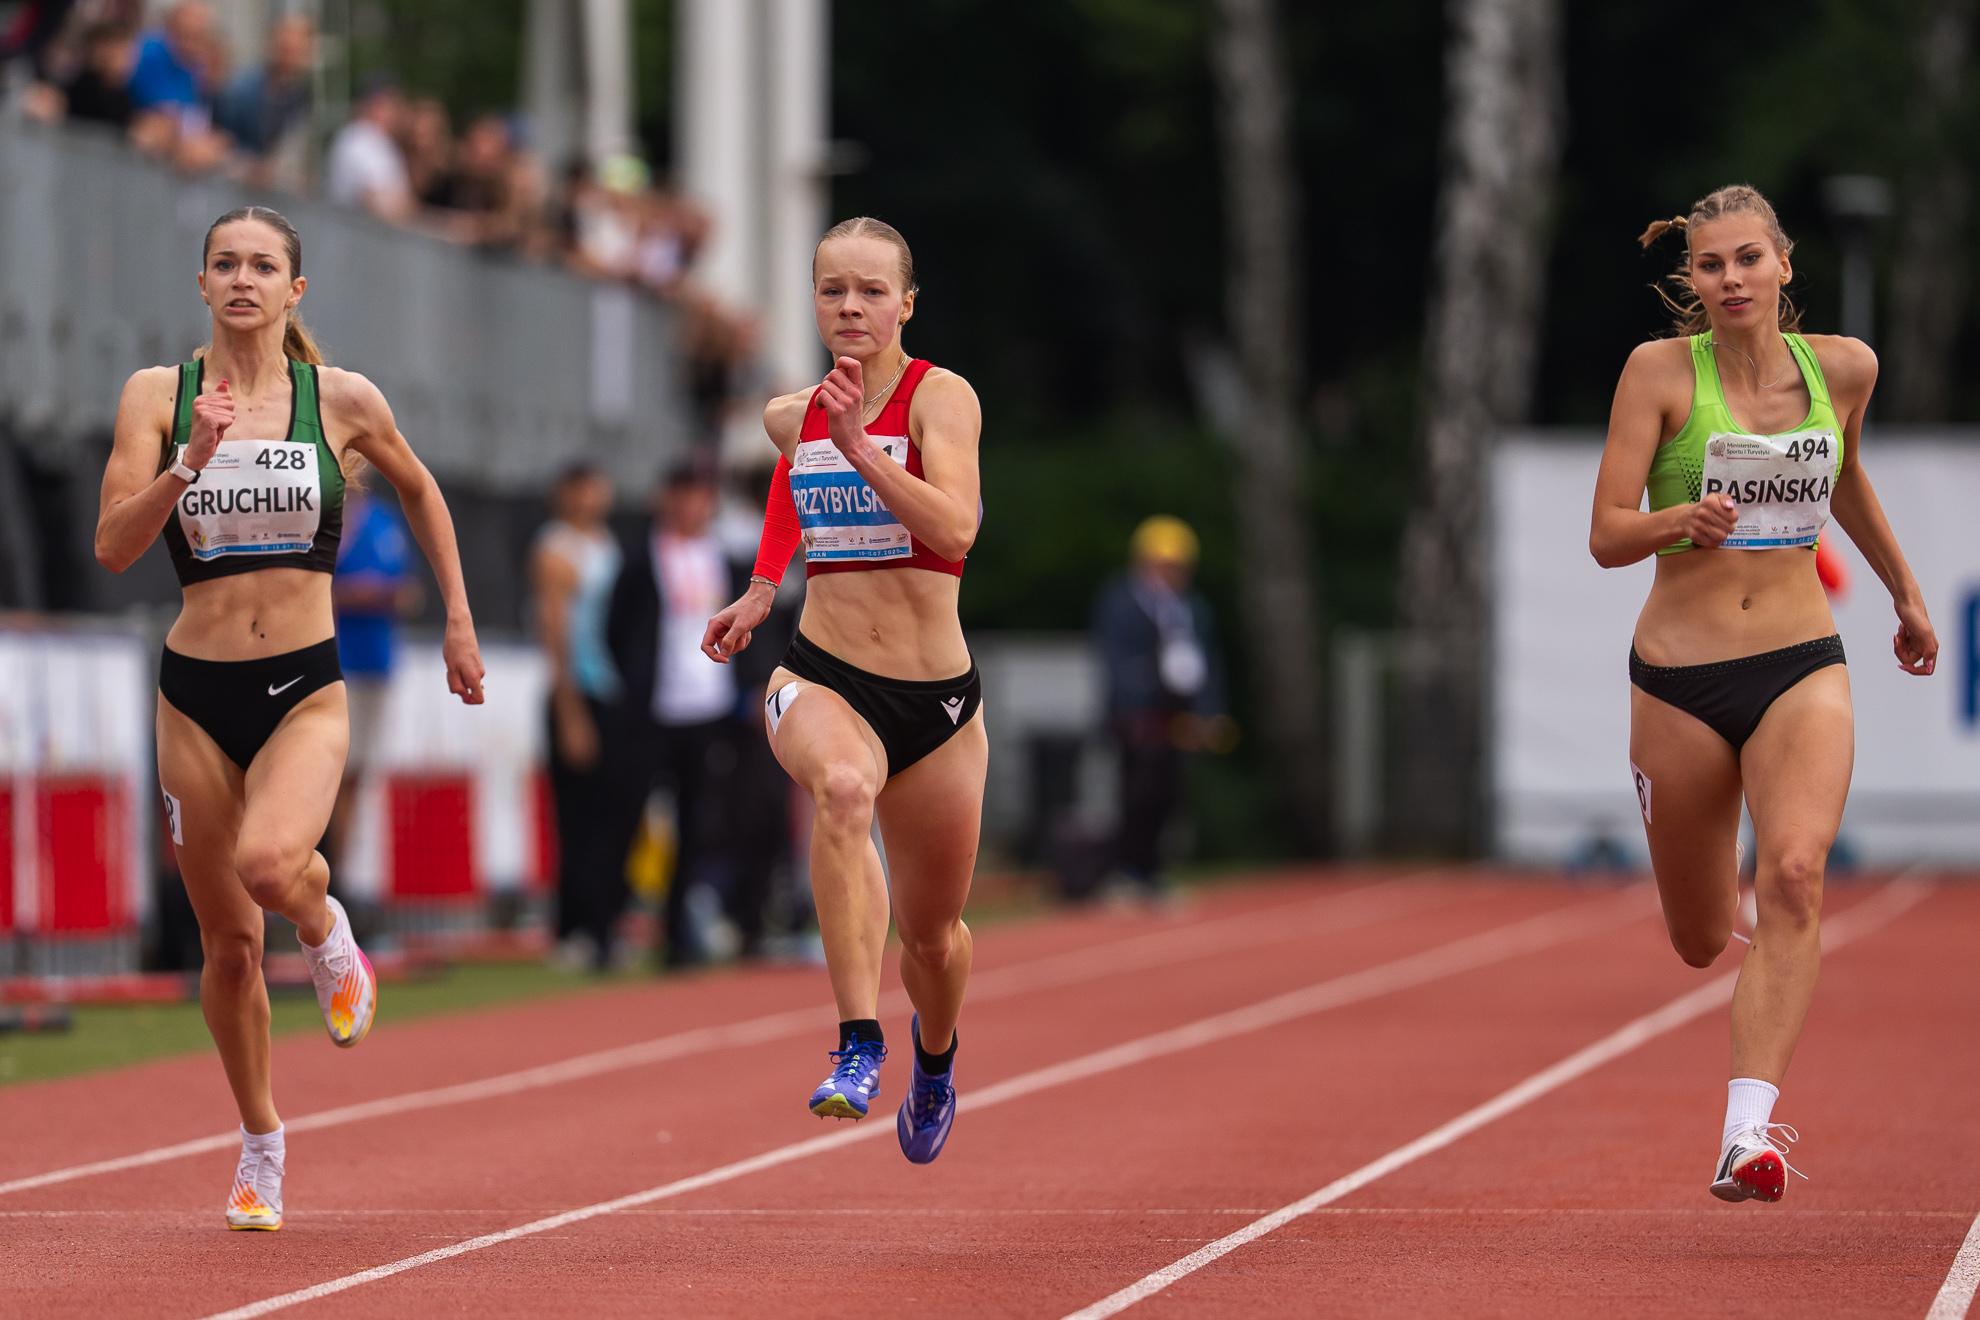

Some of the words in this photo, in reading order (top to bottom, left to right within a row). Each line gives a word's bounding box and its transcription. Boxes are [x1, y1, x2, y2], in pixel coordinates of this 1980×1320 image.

[255, 448, 306, 470] 428
[1785, 437, 1829, 462] 494
[182, 487, 314, 516] GRUCHLIK
[793, 485, 890, 516] PRZYBYLSK
[1636, 772, 1647, 811] 6
